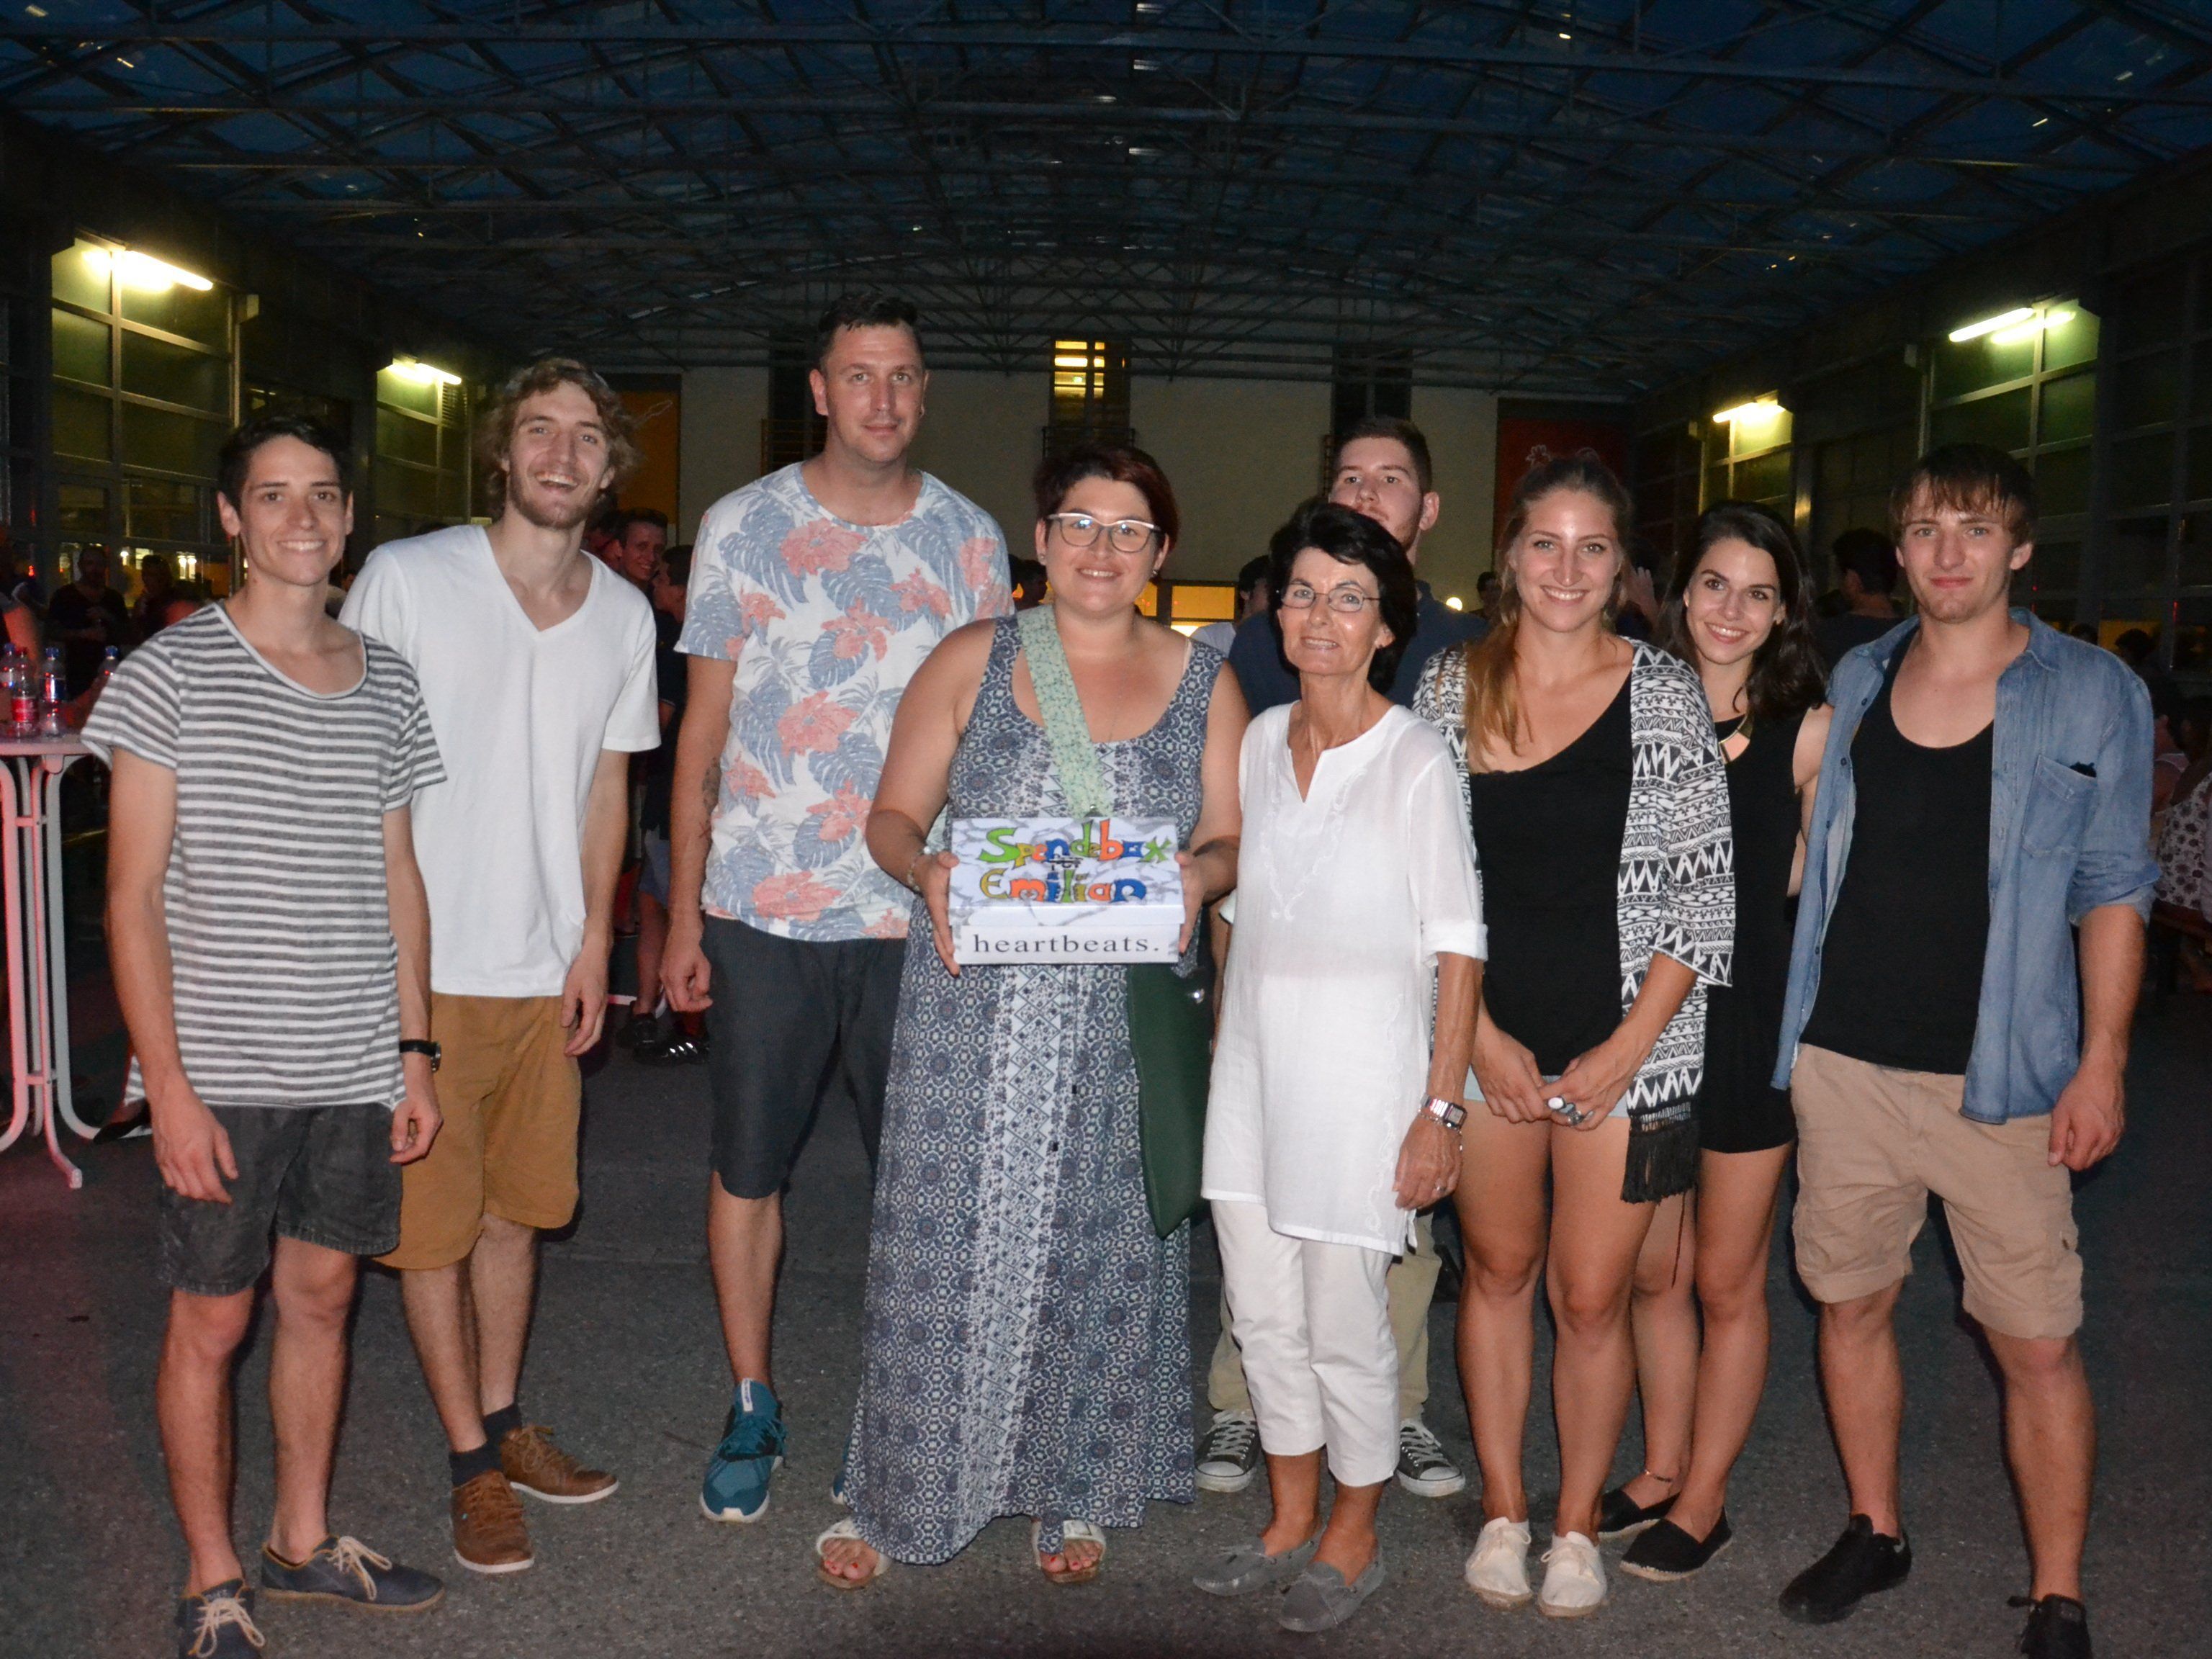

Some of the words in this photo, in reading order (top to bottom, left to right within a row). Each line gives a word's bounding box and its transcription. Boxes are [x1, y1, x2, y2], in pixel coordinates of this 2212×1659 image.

[977, 819, 1172, 870] Spendebox
[980, 868, 1147, 903] Emilian
[974, 935, 1159, 953] heartbeats.
